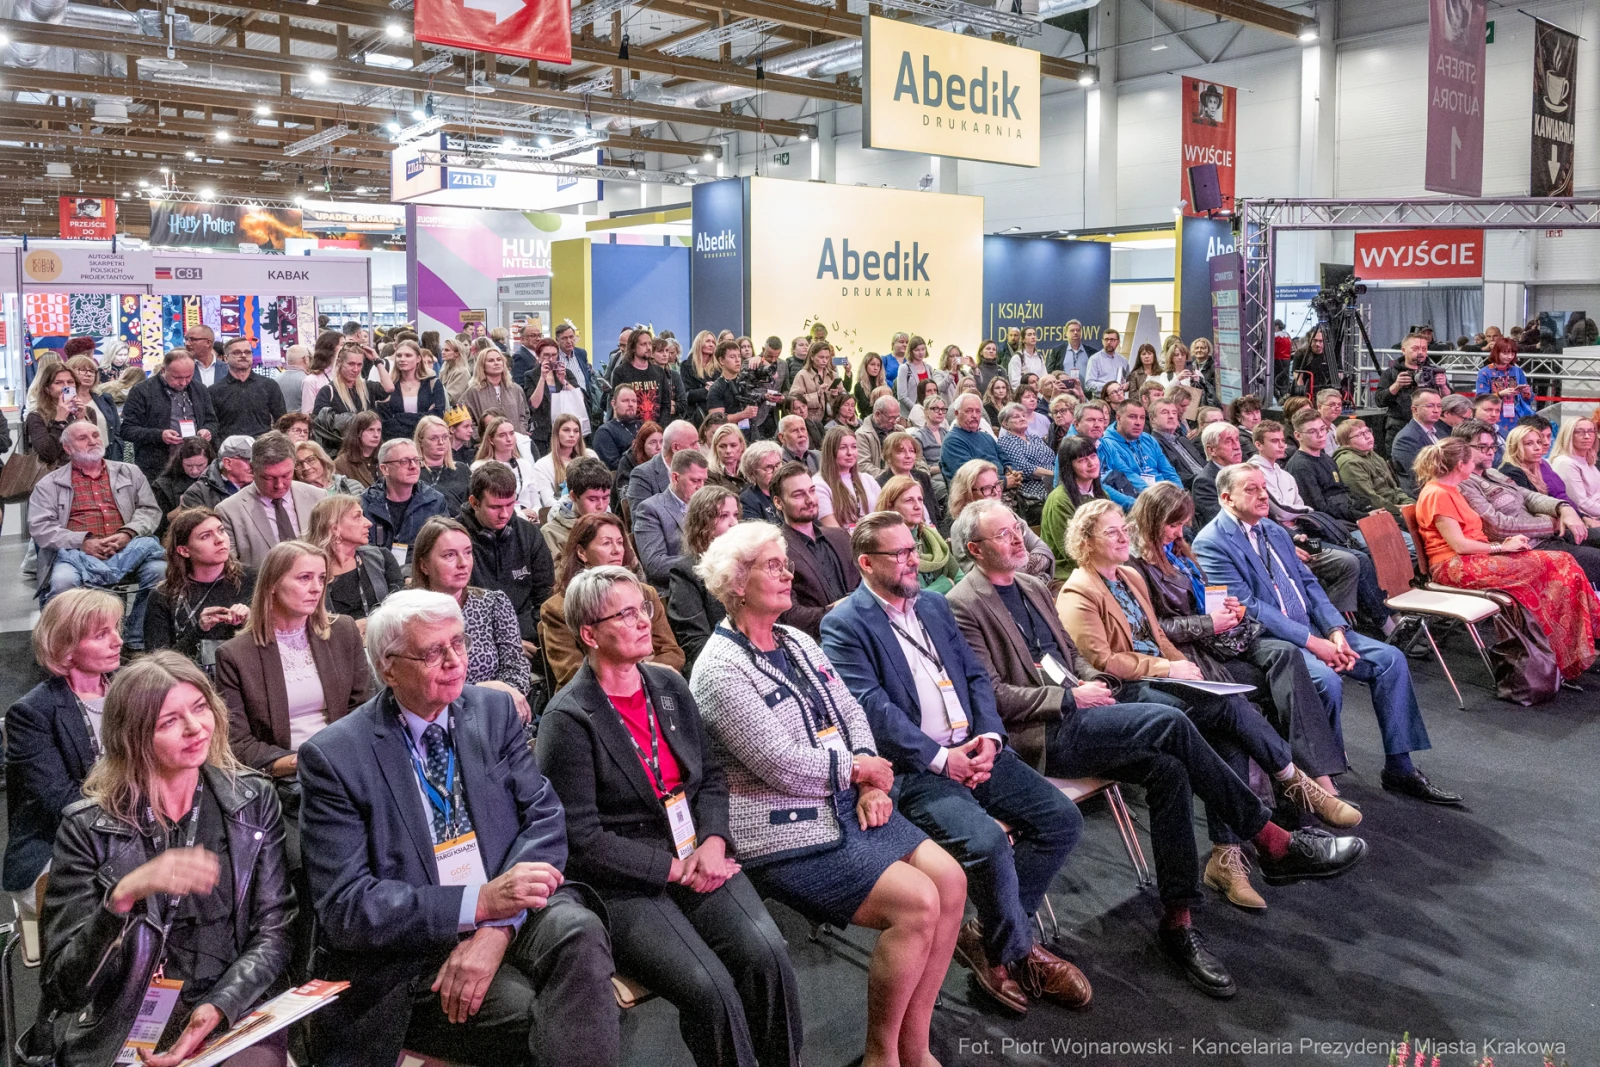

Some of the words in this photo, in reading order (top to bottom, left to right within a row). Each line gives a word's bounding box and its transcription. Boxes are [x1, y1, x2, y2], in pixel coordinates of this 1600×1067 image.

[893, 51, 1022, 120] Abedik
[922, 114, 1022, 139] DRUKARNIA
[1534, 113, 1574, 144] KAWIARNIA
[1184, 144, 1233, 167] WYJŚCIE
[452, 173, 494, 188] znak
[69, 220, 107, 229] PRZEJŚCIE
[167, 214, 202, 236] Harry
[202, 213, 236, 239] Potter
[315, 212, 355, 221] UPADEK
[696, 229, 736, 252] Abedik
[816, 237, 931, 282] Abedik
[1360, 240, 1476, 268] WYJŚCIE
[80, 273, 135, 281] PROJEKTANTÓW
[176, 268, 202, 279] C81
[267, 270, 310, 281] KABAK
[841, 286, 931, 297] DRUKARNIA
[998, 300, 1043, 323] KSIĄŻKI
[436, 852, 453, 862] TARGI
[453, 842, 477, 856] KSIĄŻKI
